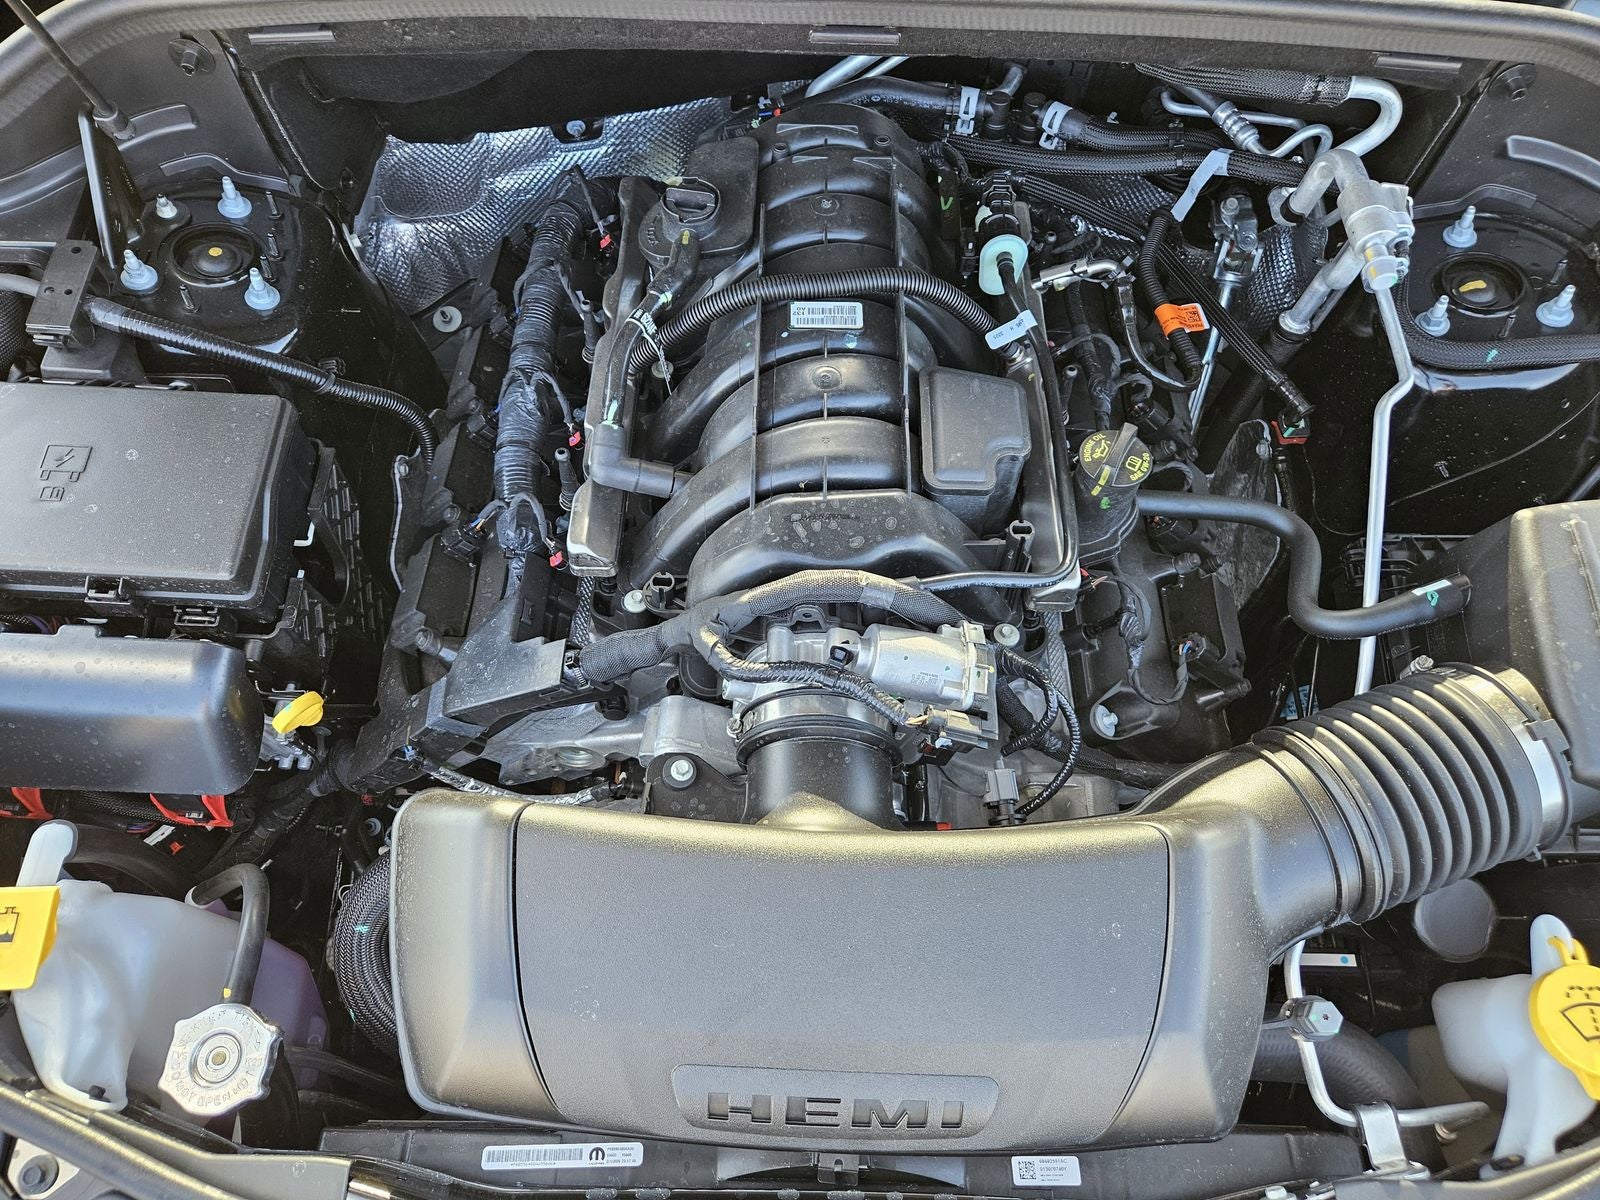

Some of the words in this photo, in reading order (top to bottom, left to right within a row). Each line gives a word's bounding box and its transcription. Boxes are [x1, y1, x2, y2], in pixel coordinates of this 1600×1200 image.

[1084, 440, 1096, 462] ENGINE
[1092, 433, 1106, 441] OIL
[1129, 470, 1144, 481] SAE
[175, 1080, 198, 1103] NOT
[197, 1091, 231, 1107] OPEN
[707, 1092, 965, 1129] HEMI
